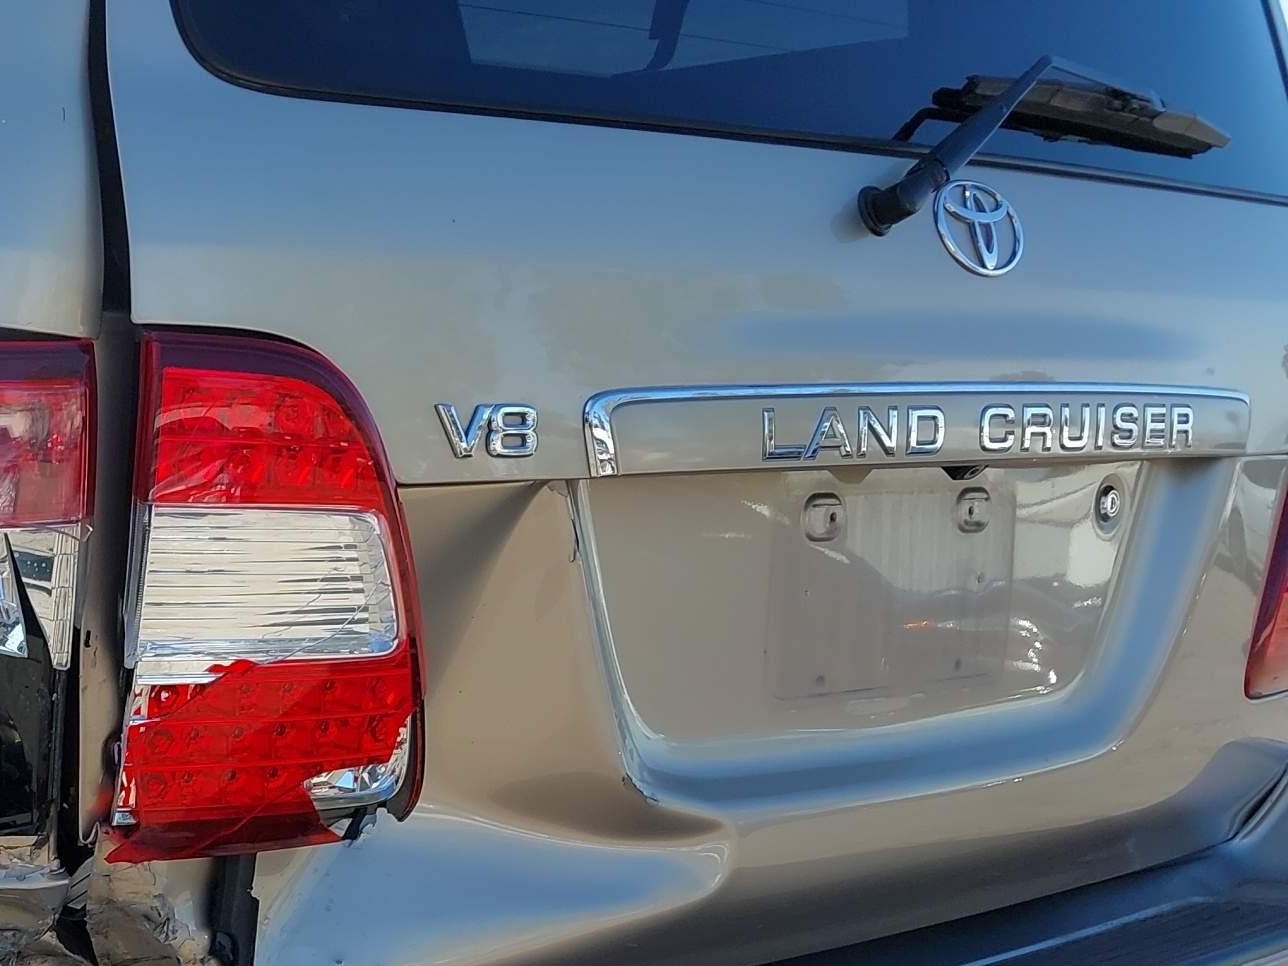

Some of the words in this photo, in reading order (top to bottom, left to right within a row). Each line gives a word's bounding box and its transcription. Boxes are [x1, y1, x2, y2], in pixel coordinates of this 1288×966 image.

[434, 403, 538, 458] V8
[761, 404, 946, 461] LAND
[978, 402, 1194, 452] CRUISER
